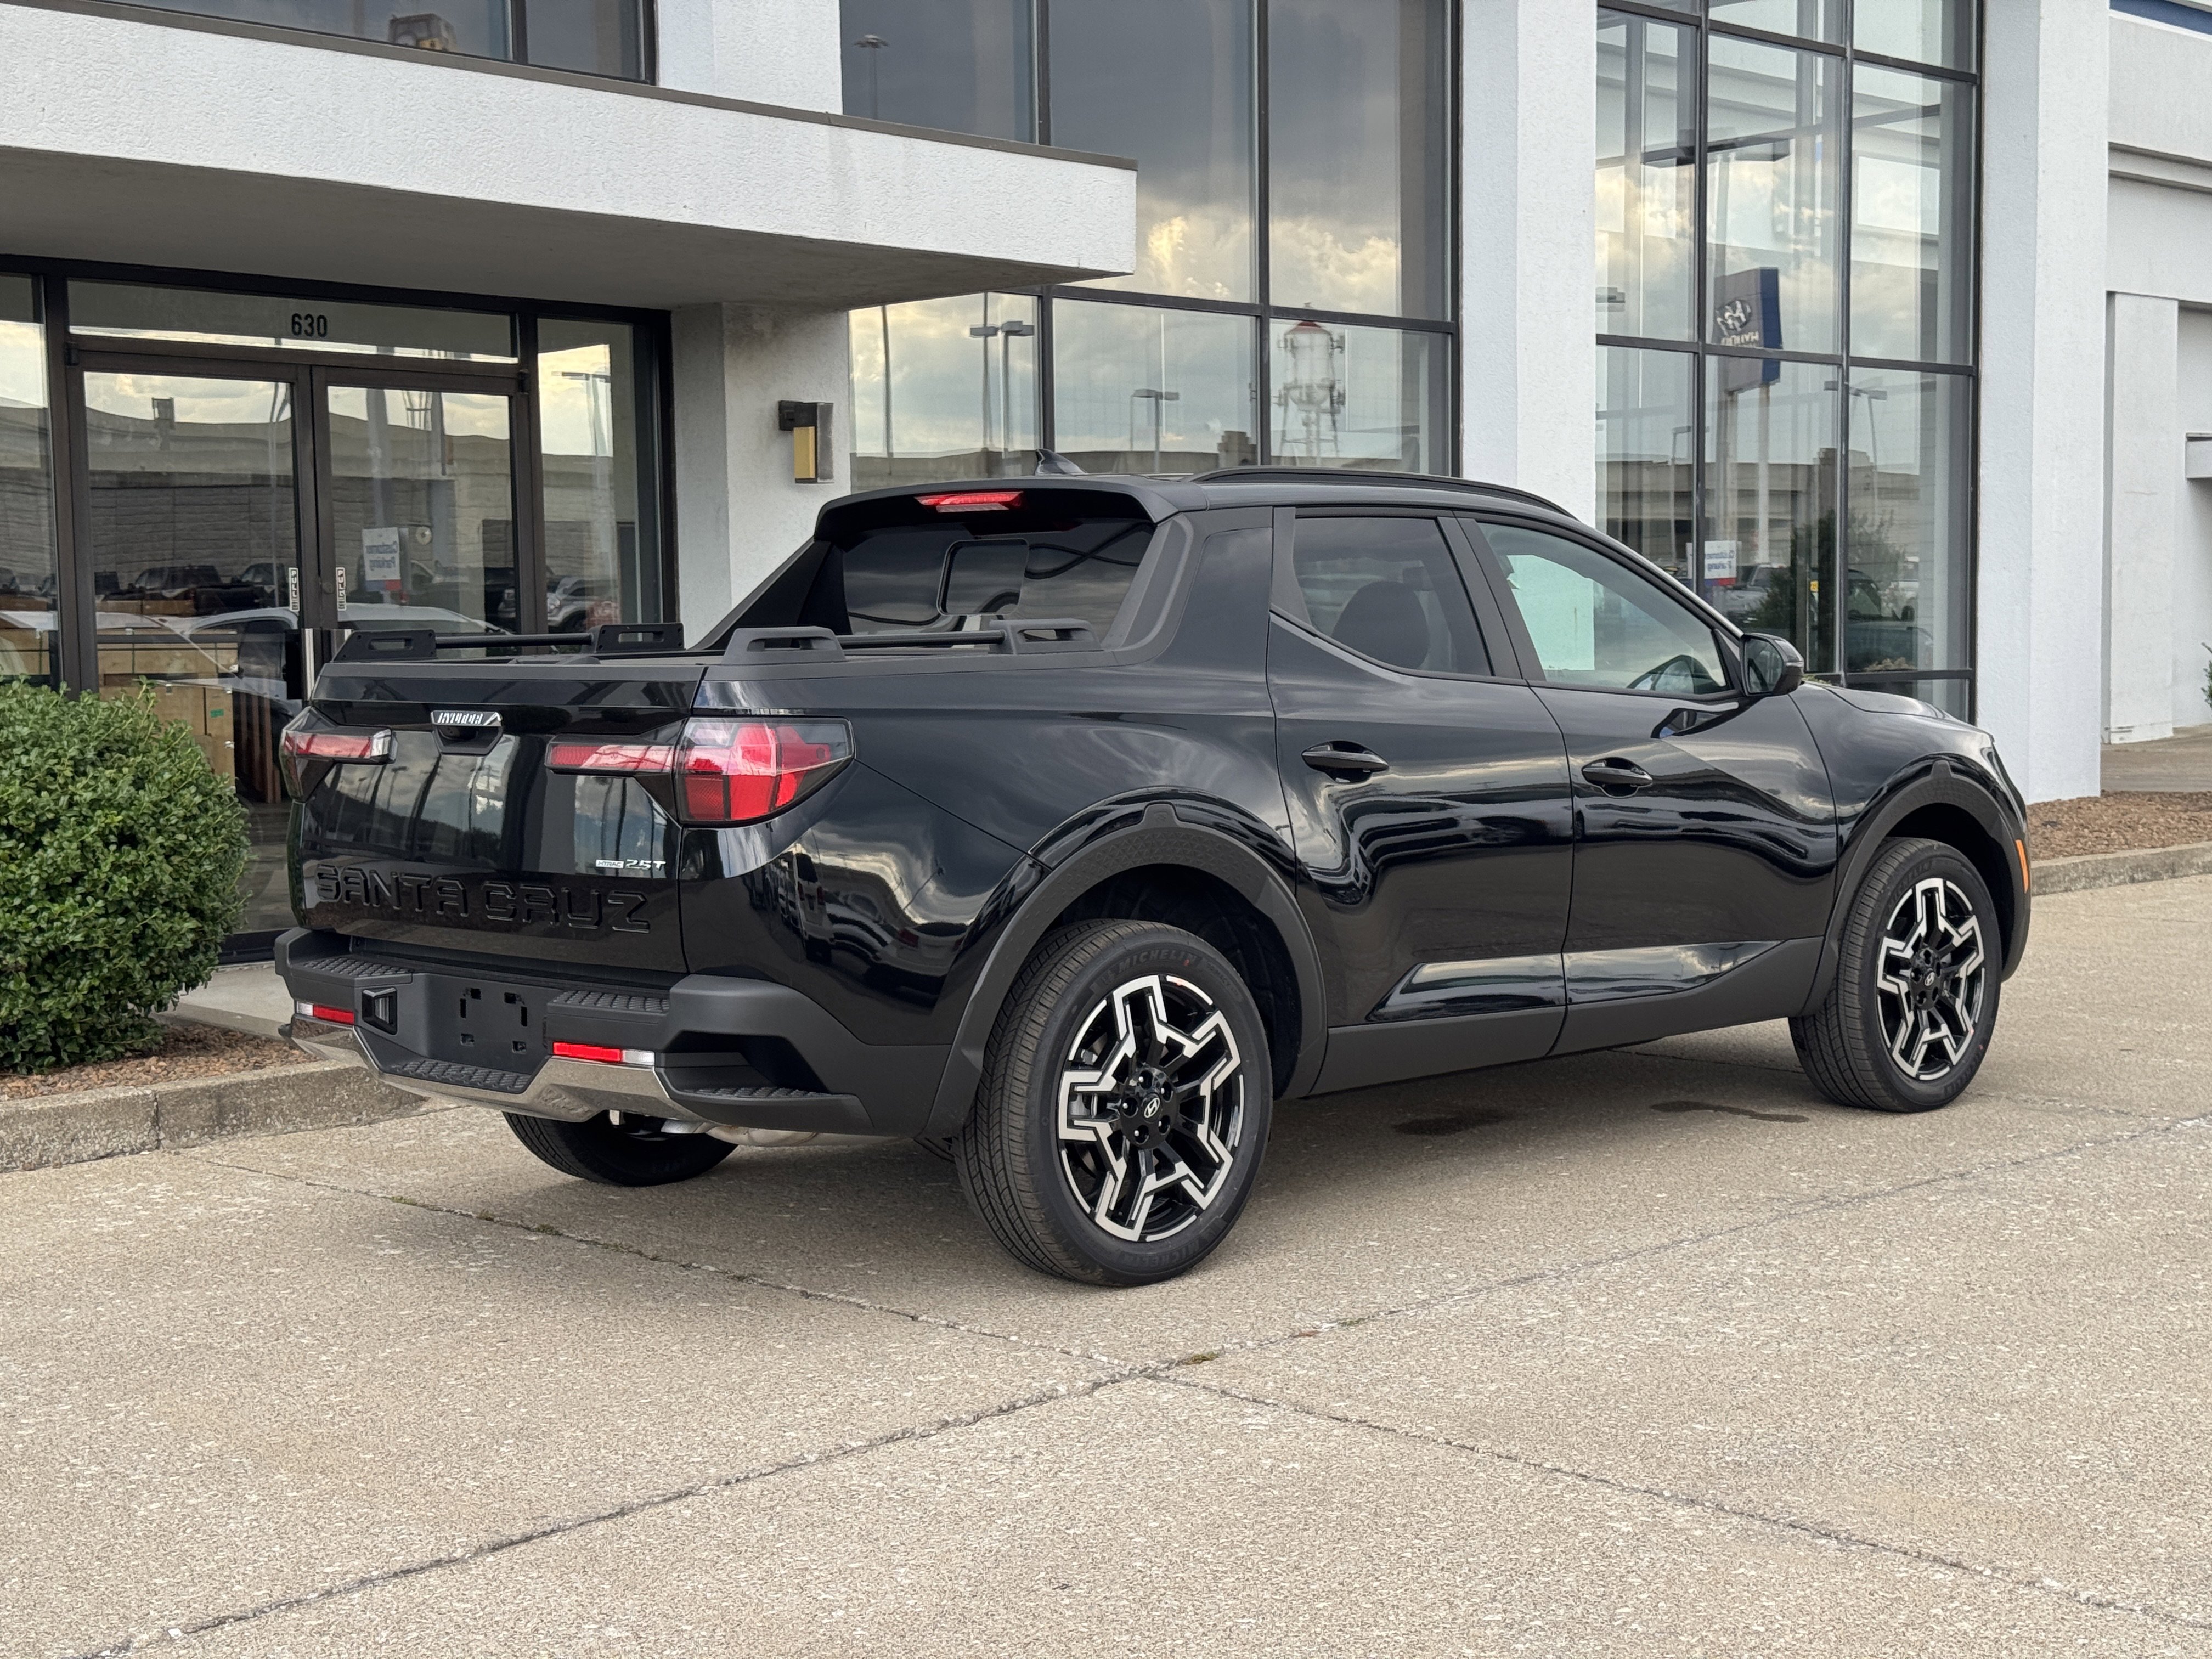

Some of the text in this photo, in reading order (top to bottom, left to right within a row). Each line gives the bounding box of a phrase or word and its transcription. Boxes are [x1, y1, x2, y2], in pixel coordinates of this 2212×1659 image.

[291, 313, 328, 337] 630
[315, 863, 651, 933] SANTA CRUZ
[1119, 949, 1198, 973] MICHELIN
